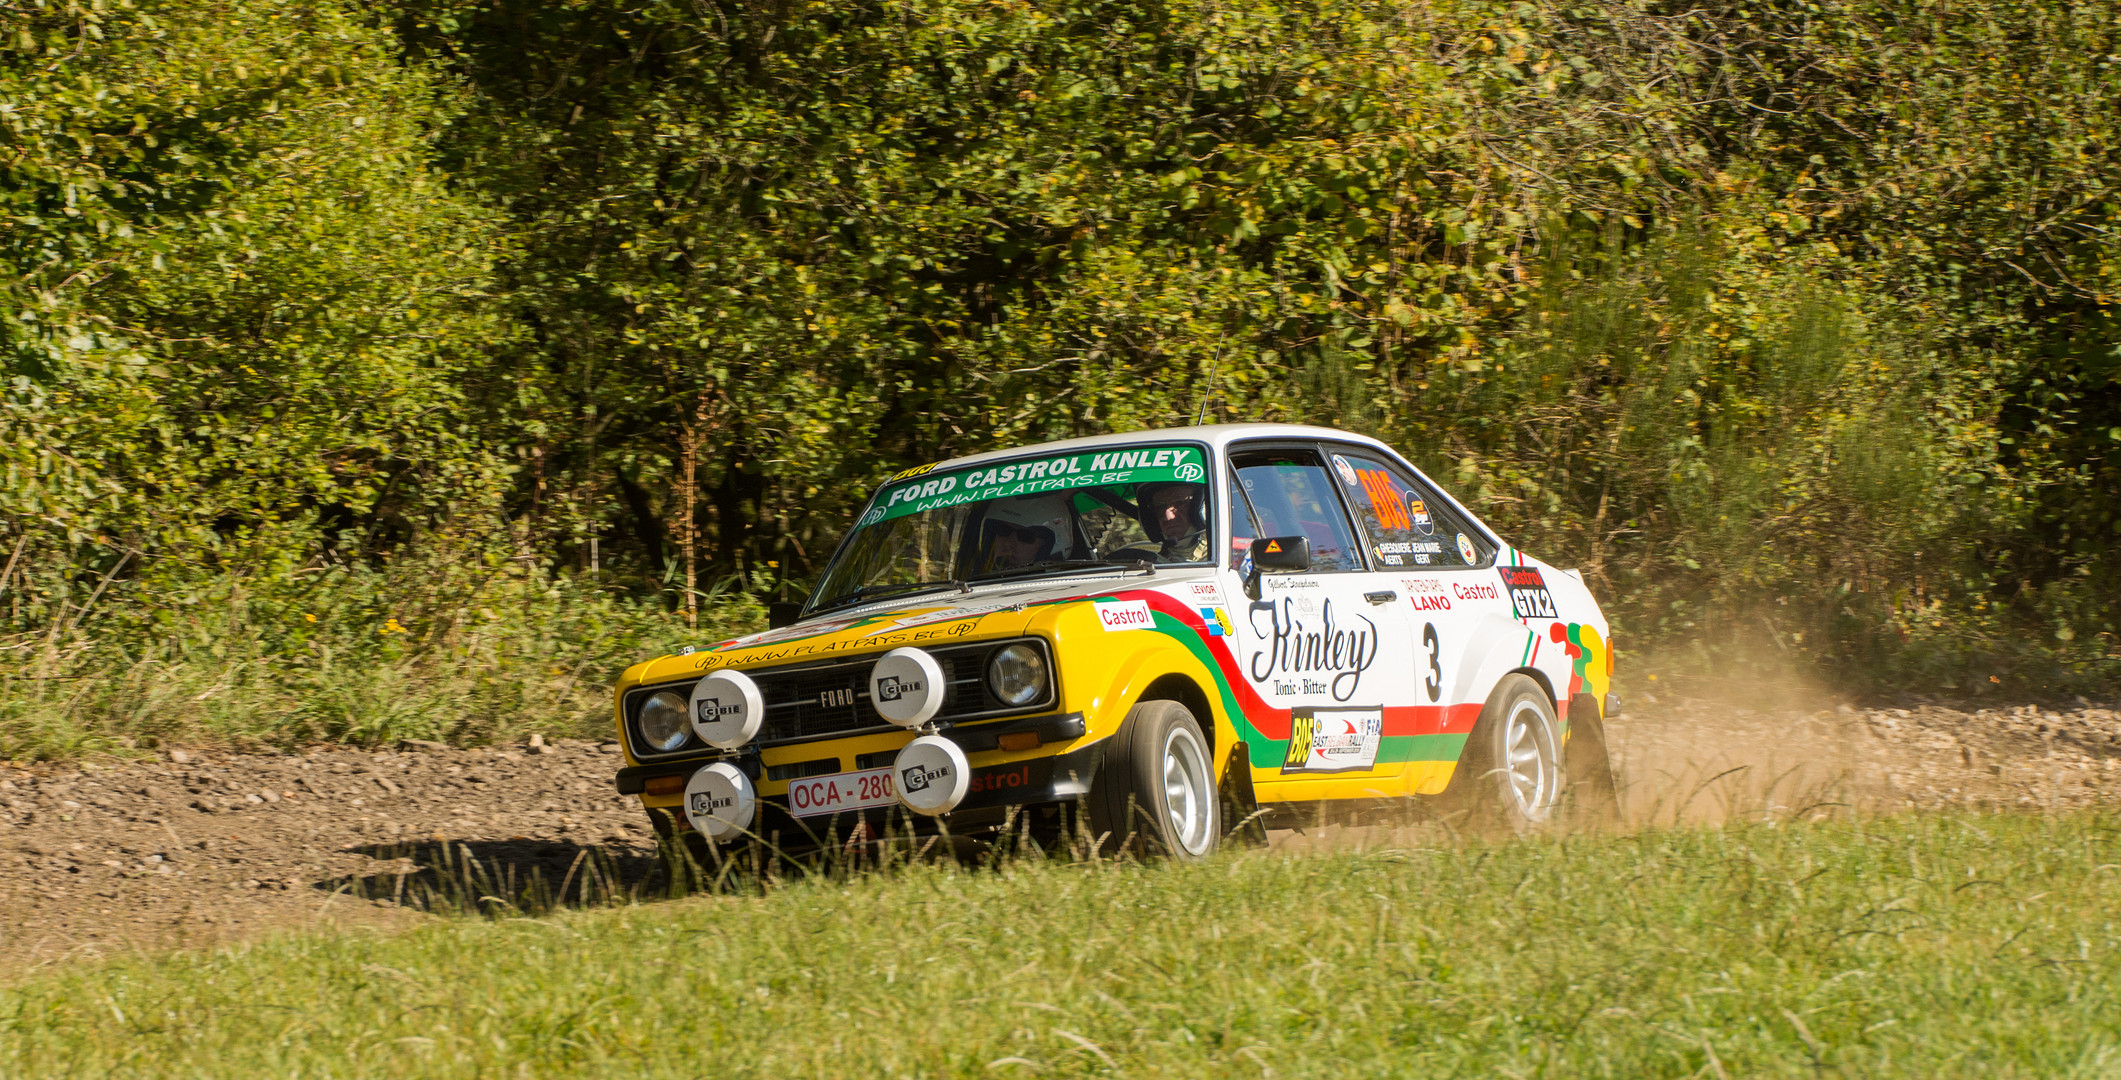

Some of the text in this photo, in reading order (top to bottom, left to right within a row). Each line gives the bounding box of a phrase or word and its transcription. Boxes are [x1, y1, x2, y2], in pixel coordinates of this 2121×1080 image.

[888, 449, 1191, 507] FORD CASTROL KINLEY
[916, 471, 1133, 512] WWW.PLATPAYS.BE
[1356, 469, 1410, 530] B05
[1385, 554, 1430, 565] AERTS GERT
[1191, 585, 1217, 594] LEVIOR
[1502, 568, 1544, 586] Castrol
[1410, 595, 1451, 611] LANO
[1453, 582, 1499, 600] Castrol
[1512, 589, 1556, 617] GTX2
[1102, 606, 1150, 626] Castrol
[726, 630, 945, 666] WWW.PLATPAYS.BE
[1250, 597, 1378, 702] Kinley
[1423, 622, 1442, 702] 3
[820, 688, 853, 708] FORD
[1274, 679, 1327, 696] Tonic Bitter
[1288, 717, 1313, 763] B05
[794, 781, 842, 809] OCA
[858, 773, 893, 801] 280
[971, 766, 1029, 793] strol
